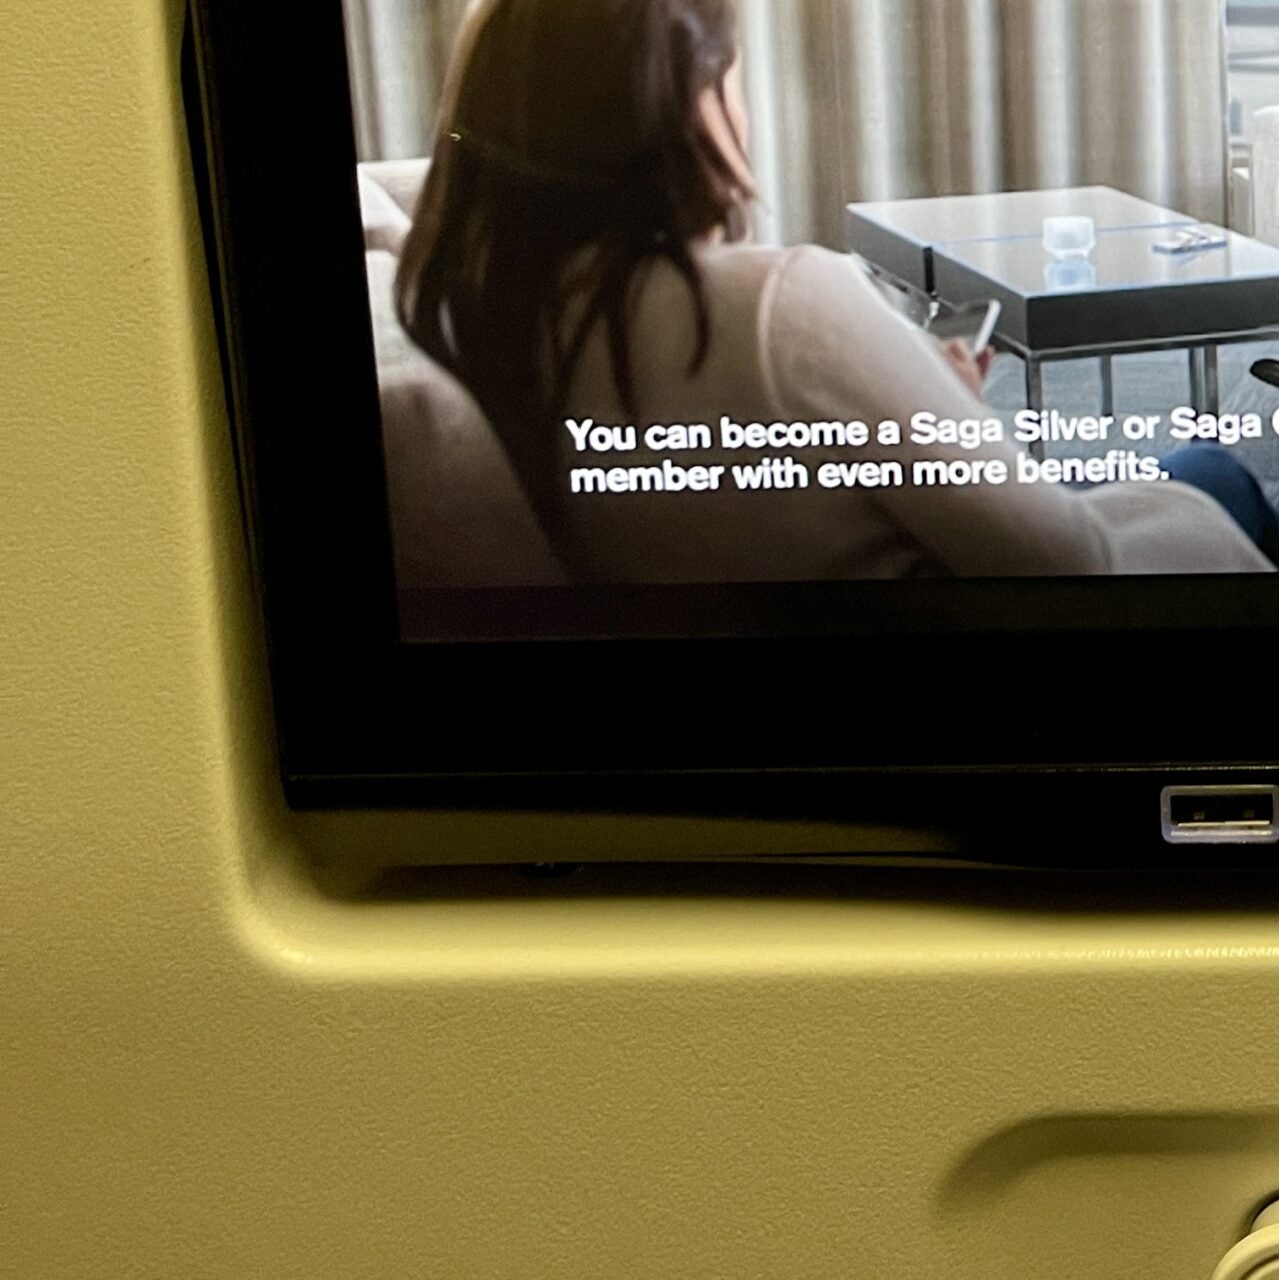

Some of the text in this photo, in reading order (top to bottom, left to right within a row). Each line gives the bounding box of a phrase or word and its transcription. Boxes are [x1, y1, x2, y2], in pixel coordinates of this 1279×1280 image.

[566, 418, 637, 452] You
[644, 423, 711, 450] can
[721, 416, 869, 449] become
[877, 419, 901, 445] a
[910, 411, 1004, 449] Saga
[1014, 408, 1114, 443] Silver
[1123, 414, 1161, 440] or
[1169, 405, 1263, 445] Saga
[570, 450, 1170, 493] member with even more benefits.
